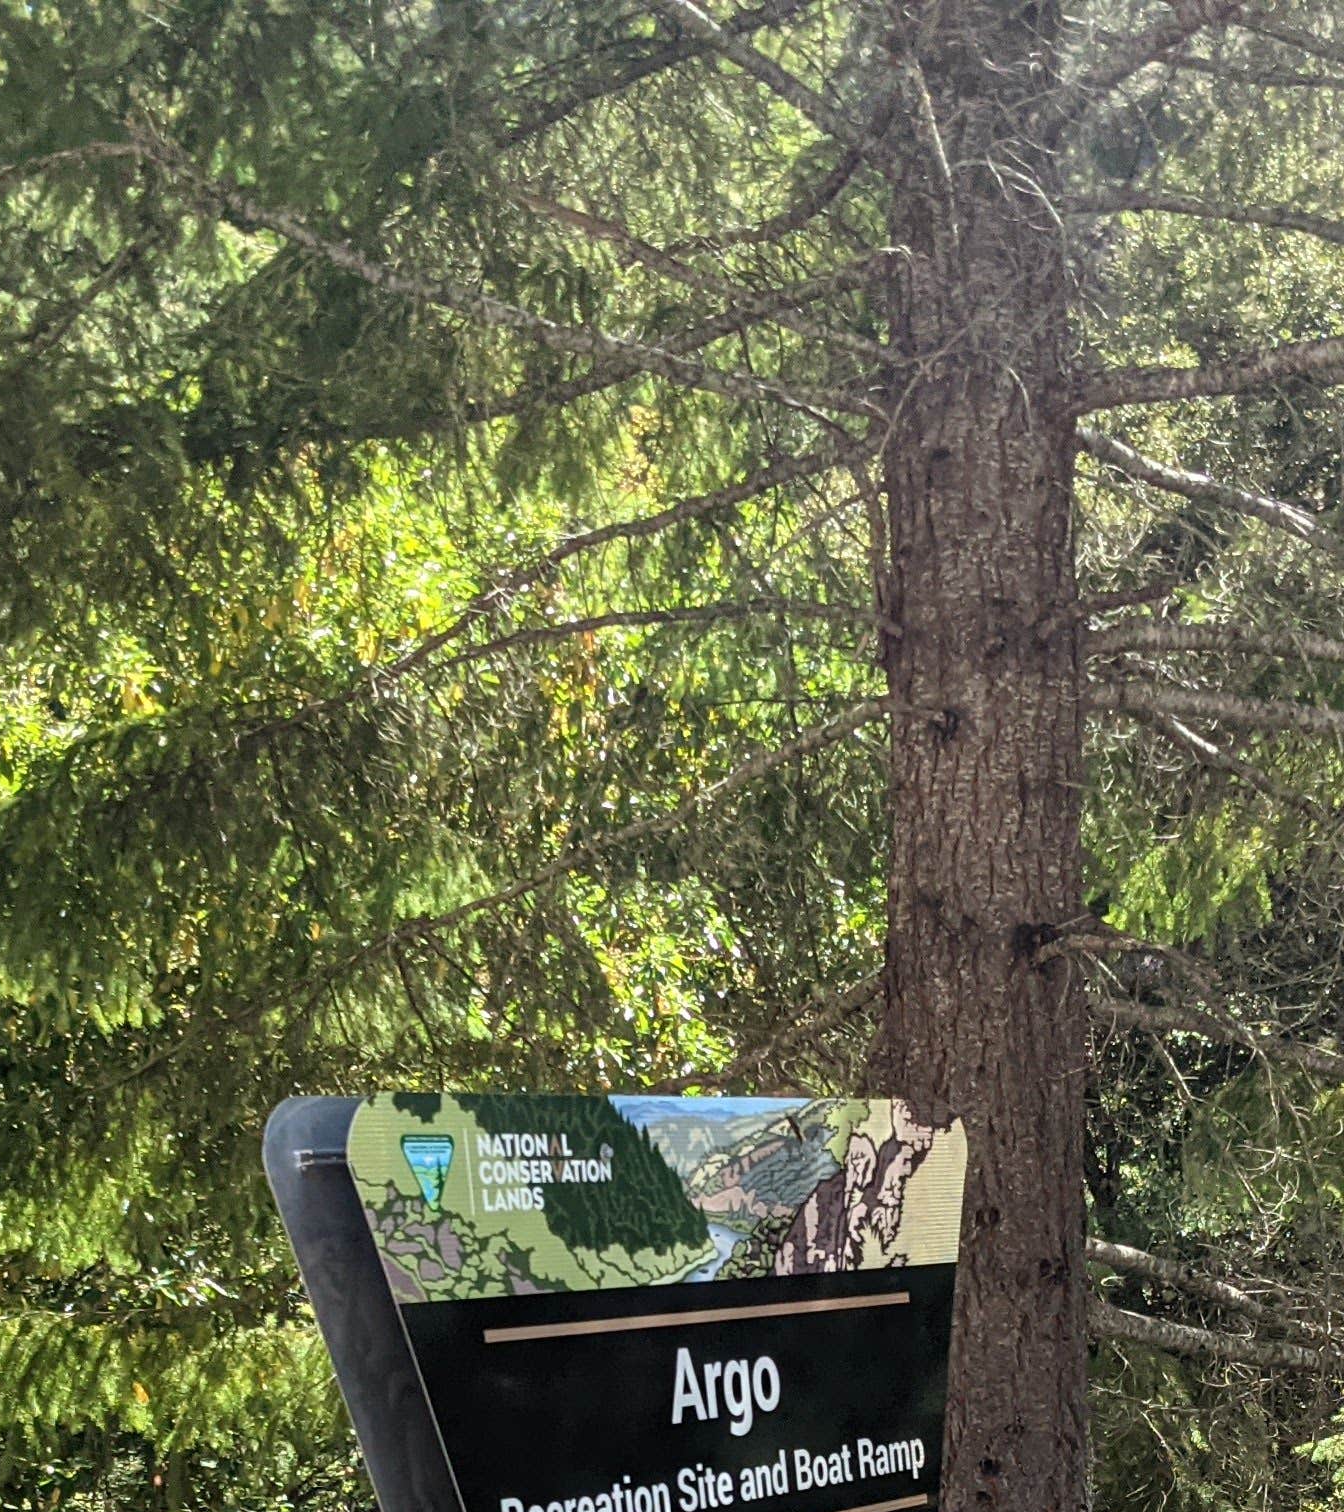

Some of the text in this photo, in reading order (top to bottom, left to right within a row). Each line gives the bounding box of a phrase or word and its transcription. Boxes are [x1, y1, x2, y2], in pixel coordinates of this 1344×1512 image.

[476, 1133, 573, 1157] NATIONAL
[479, 1159, 612, 1184] CONSERVATION
[482, 1186, 544, 1212] LANDS
[672, 1347, 780, 1436] Argo
[677, 1463, 734, 1512] Site
[740, 1449, 789, 1501] and
[794, 1444, 853, 1491] Boat
[857, 1437, 925, 1479] Ramp
